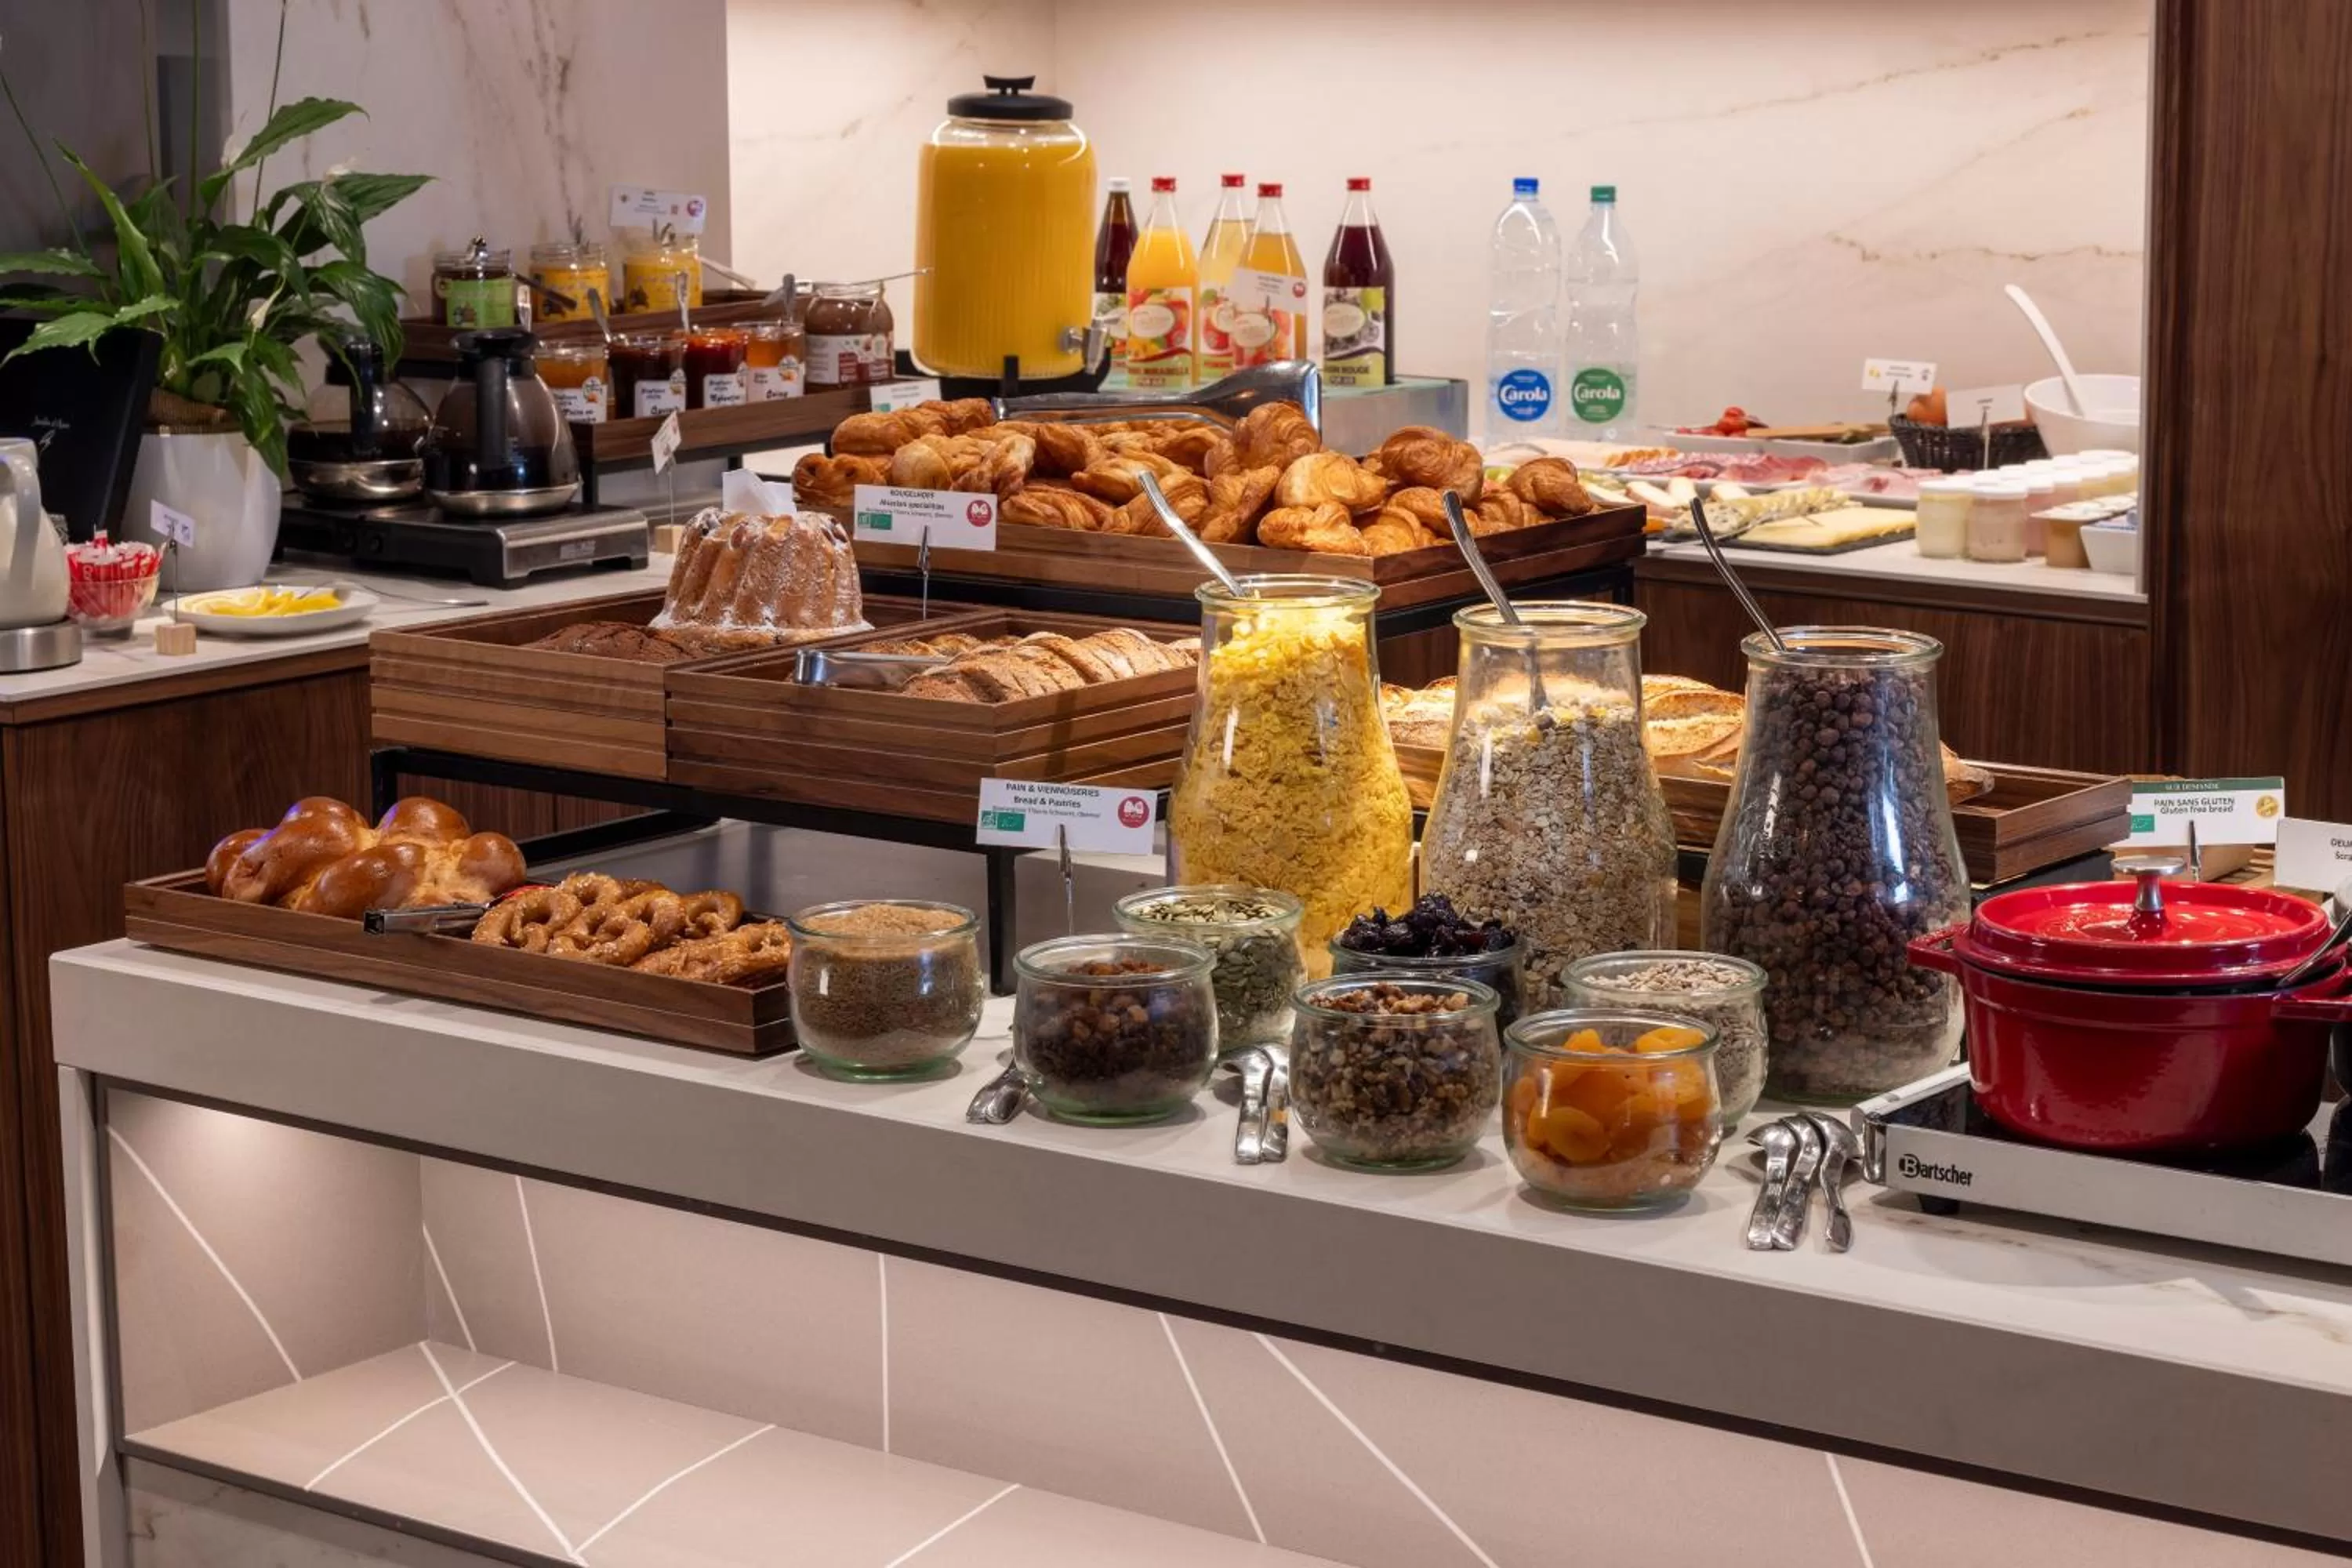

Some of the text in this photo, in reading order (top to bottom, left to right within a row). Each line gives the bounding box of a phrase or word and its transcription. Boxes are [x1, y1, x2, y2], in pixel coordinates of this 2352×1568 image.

[1500, 384, 1548, 405] Carola
[1573, 383, 1621, 403] Carola
[1006, 783, 1026, 792] PAIN
[1037, 786, 1099, 797] VIENNOISERIES
[1014, 796, 1081, 809] Bread & Pastries
[2154, 797, 2234, 808] PAIN SANS GLUTEN
[2160, 804, 2234, 815] Gluten free bread
[1898, 1153, 1973, 1187] Bartscher
